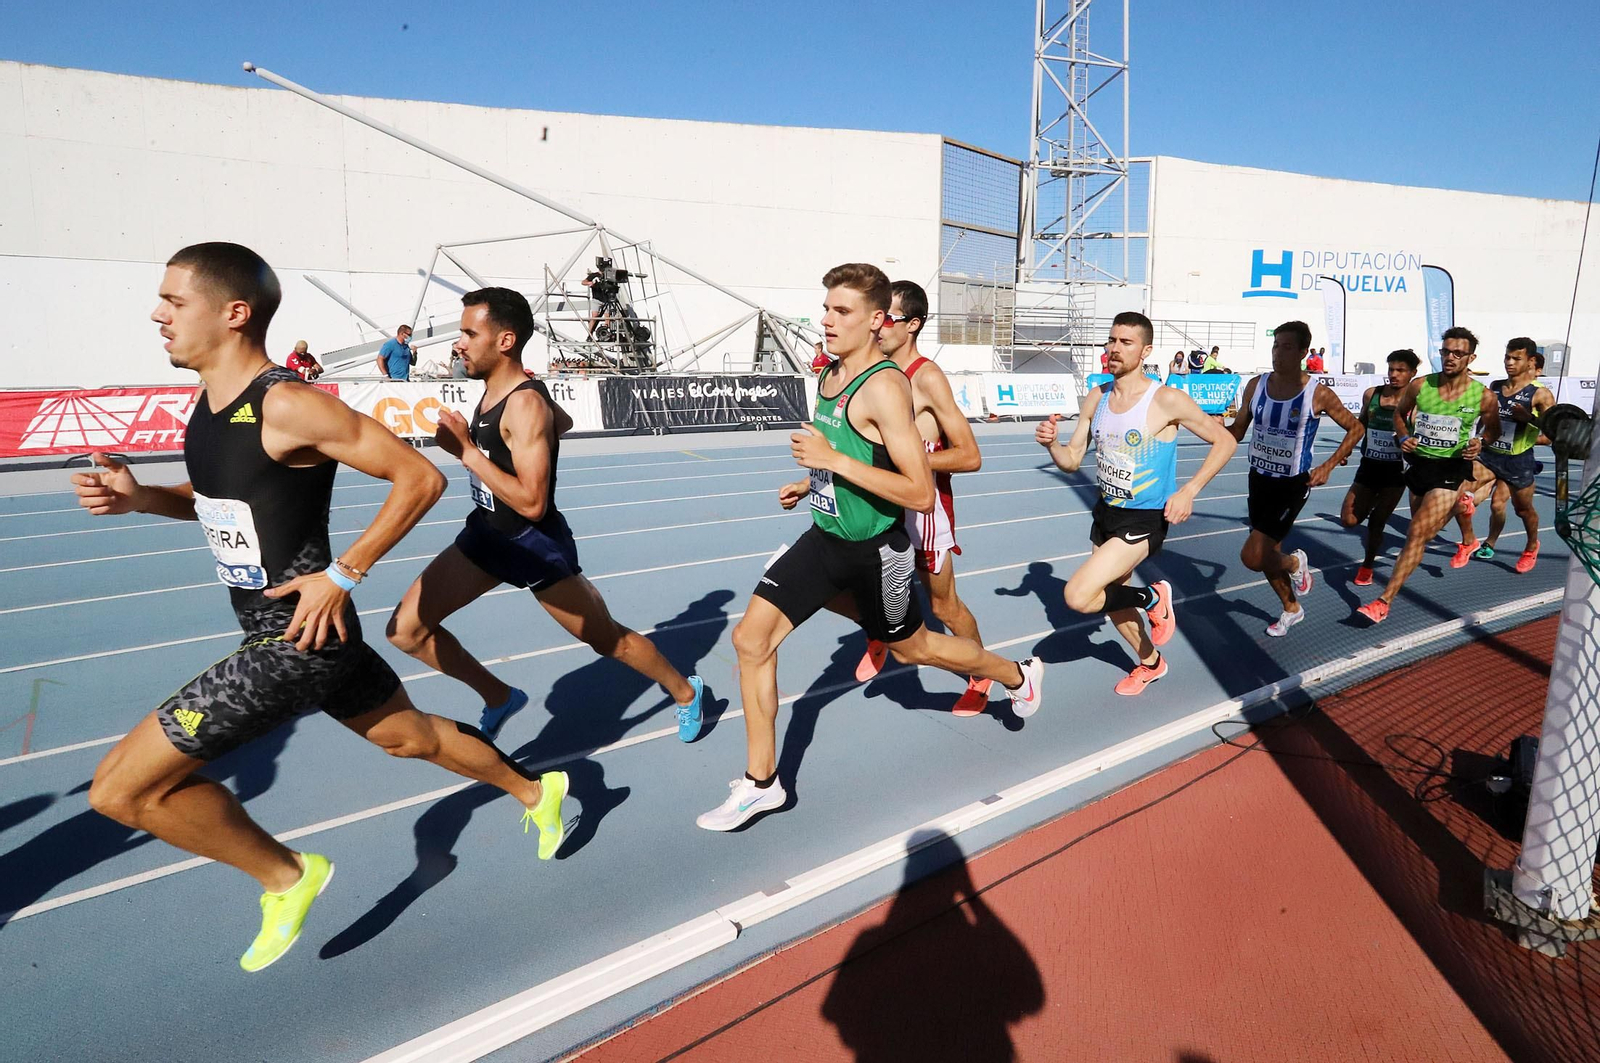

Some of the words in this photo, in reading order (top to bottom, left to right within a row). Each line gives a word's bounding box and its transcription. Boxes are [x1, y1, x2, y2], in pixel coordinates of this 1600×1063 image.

[1302, 249, 1422, 271] DIPUTACIÓN
[1301, 273, 1324, 291] DE
[440, 383, 467, 403] fit
[551, 383, 576, 401] fit
[631, 388, 685, 400] VIAJES
[735, 378, 778, 403] Inglés
[1032, 392, 1066, 400] HUELVA
[1192, 391, 1204, 399] DE
[229, 416, 257, 424] adidas
[740, 414, 783, 422] DEPORTES
[1417, 420, 1458, 433] GRONDONA
[1253, 441, 1293, 459] LORENZO
[1373, 439, 1395, 448] REDA
[1251, 458, 1287, 473] Joma
[173, 708, 198, 737] adidas
